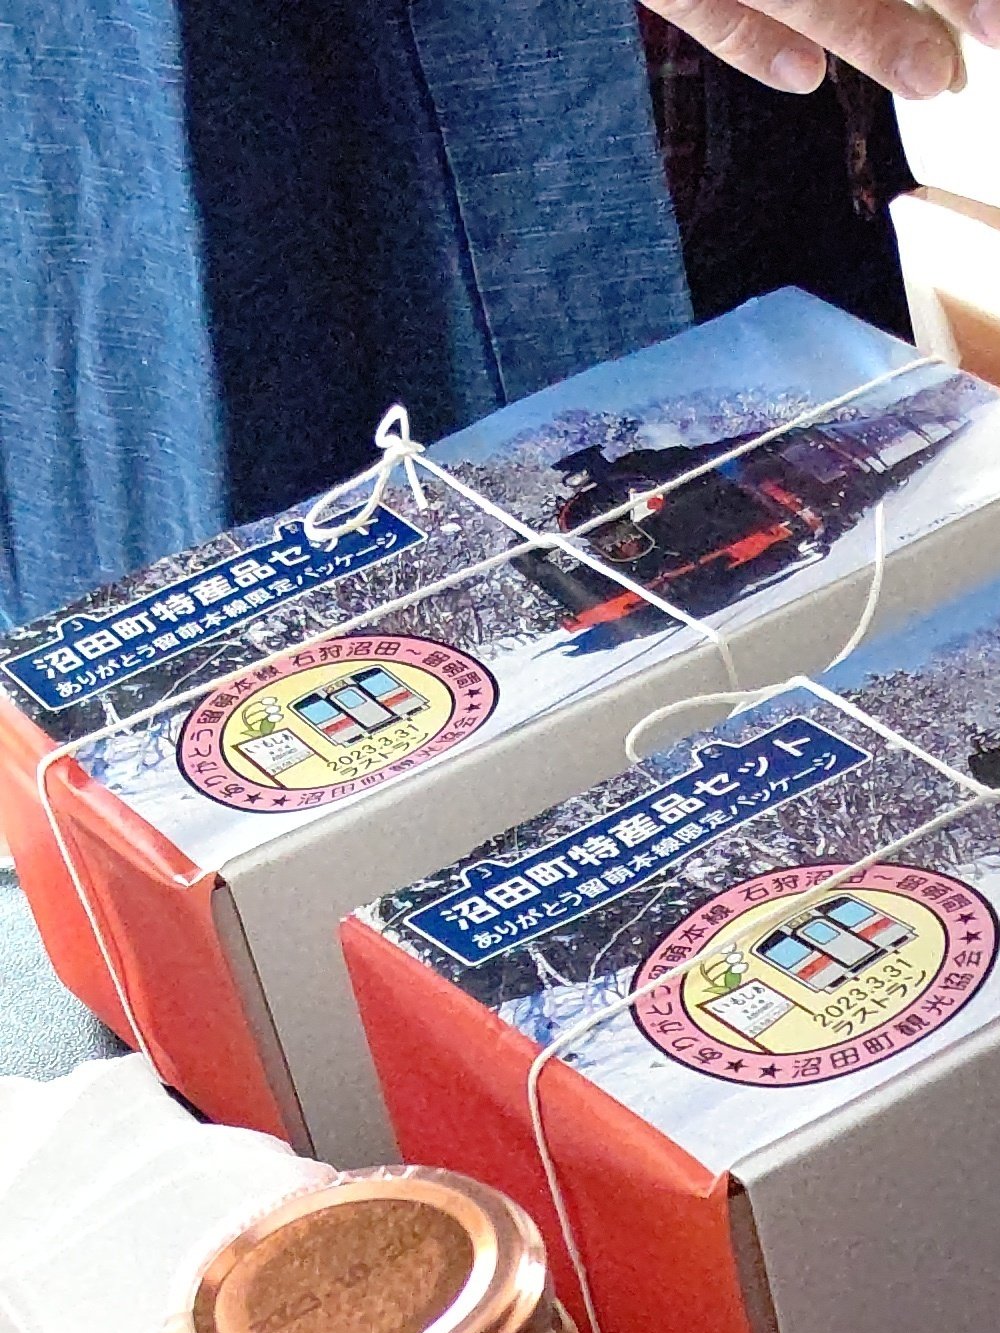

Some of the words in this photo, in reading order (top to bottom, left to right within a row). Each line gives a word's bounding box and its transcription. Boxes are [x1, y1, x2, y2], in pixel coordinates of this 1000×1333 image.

[56, 531, 398, 698] ありがとう留萌本線限定パッケージ
[327, 724, 420, 772] 2023.3.31
[339, 732, 429, 778] ラストラン
[440, 735, 811, 931] 沼田町特産品セット
[471, 751, 838, 950] ありがとう留萌本線限定パッケージ
[791, 951, 983, 1079] 沼田町観光協会
[813, 957, 914, 1028] 2023.3.31
[831, 969, 927, 1035] ラストラン
